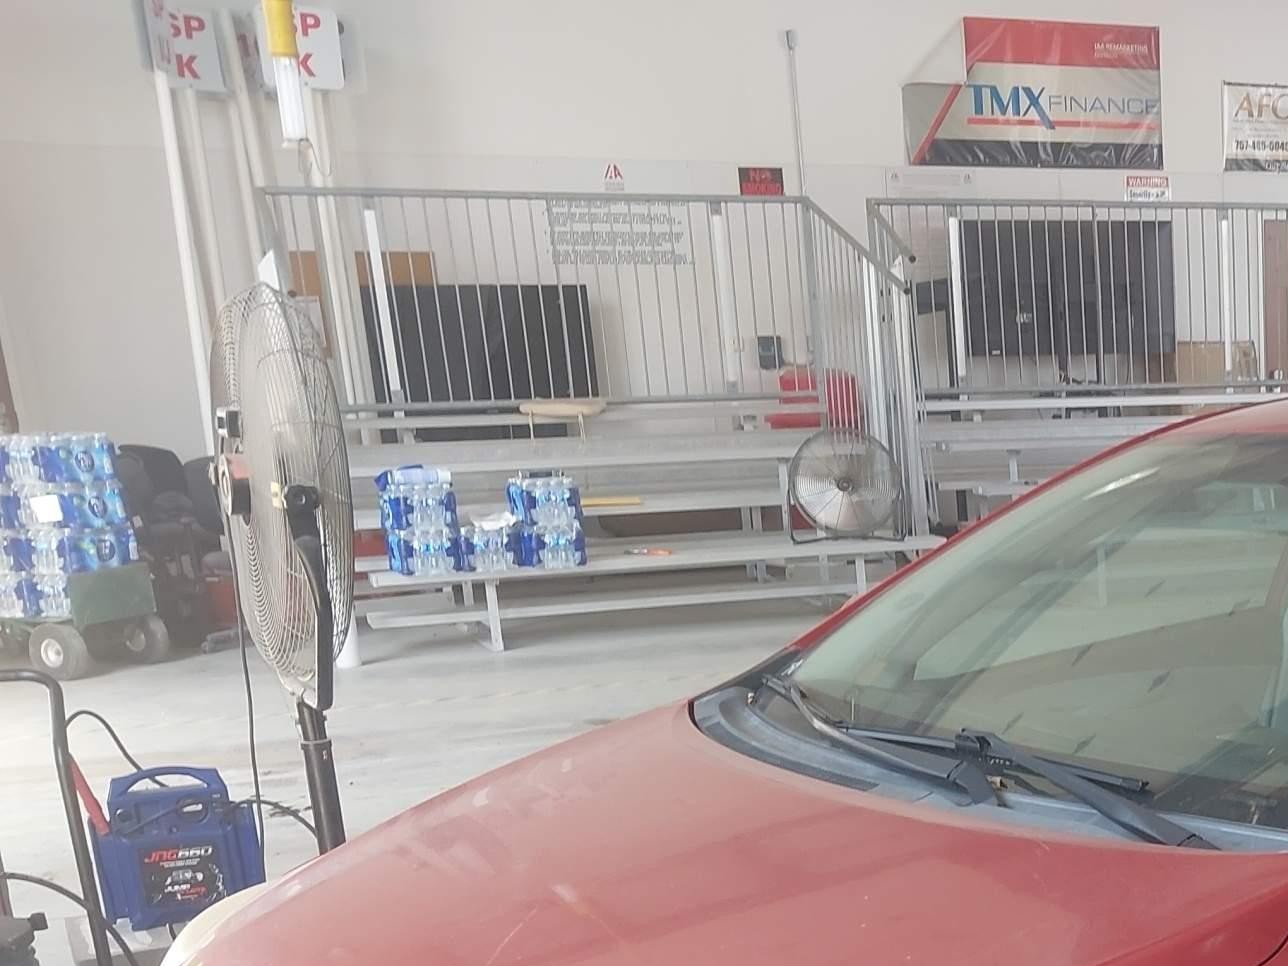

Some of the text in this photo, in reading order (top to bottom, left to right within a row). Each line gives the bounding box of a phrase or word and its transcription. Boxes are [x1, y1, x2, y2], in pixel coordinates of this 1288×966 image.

[175, 53, 201, 80] K
[966, 84, 1160, 130] TMX FINANCE
